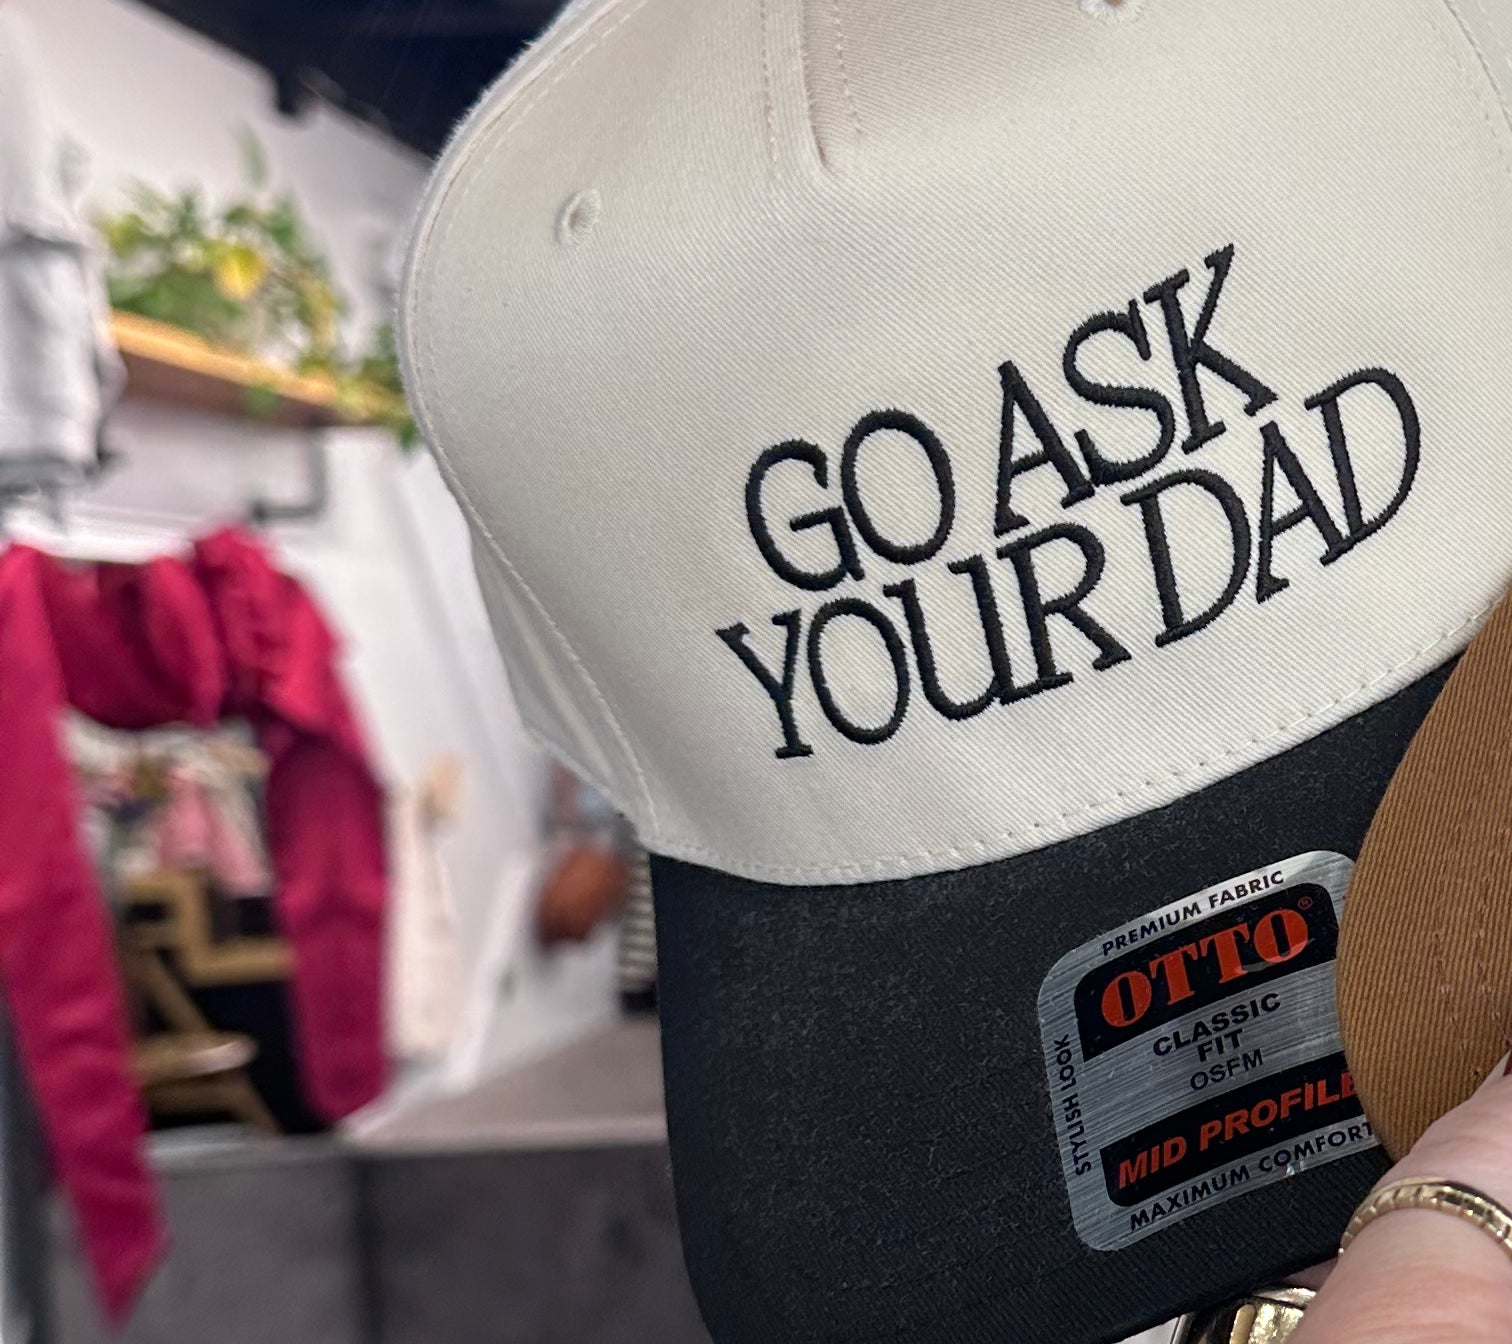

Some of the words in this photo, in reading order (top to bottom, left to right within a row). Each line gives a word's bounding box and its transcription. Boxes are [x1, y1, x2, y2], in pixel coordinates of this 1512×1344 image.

[745, 408, 955, 590] GO
[993, 243, 1278, 538] ASK
[714, 521, 1132, 759] YOUR
[1120, 367, 1421, 647] DAD
[1101, 899, 1201, 957] PREMIUM
[1208, 870, 1285, 909] FABRIC
[1053, 1033, 1076, 1090] LOOK
[1153, 992, 1281, 1057] CLASSIC
[1197, 1028, 1244, 1063] FIT
[1190, 1047, 1264, 1091] OSFM
[1061, 1091, 1092, 1175] STYLISH
[1118, 1136, 1187, 1189] MID
[1130, 1165, 1250, 1231] MAXIMUM
[1258, 1121, 1374, 1174] COMFORT
